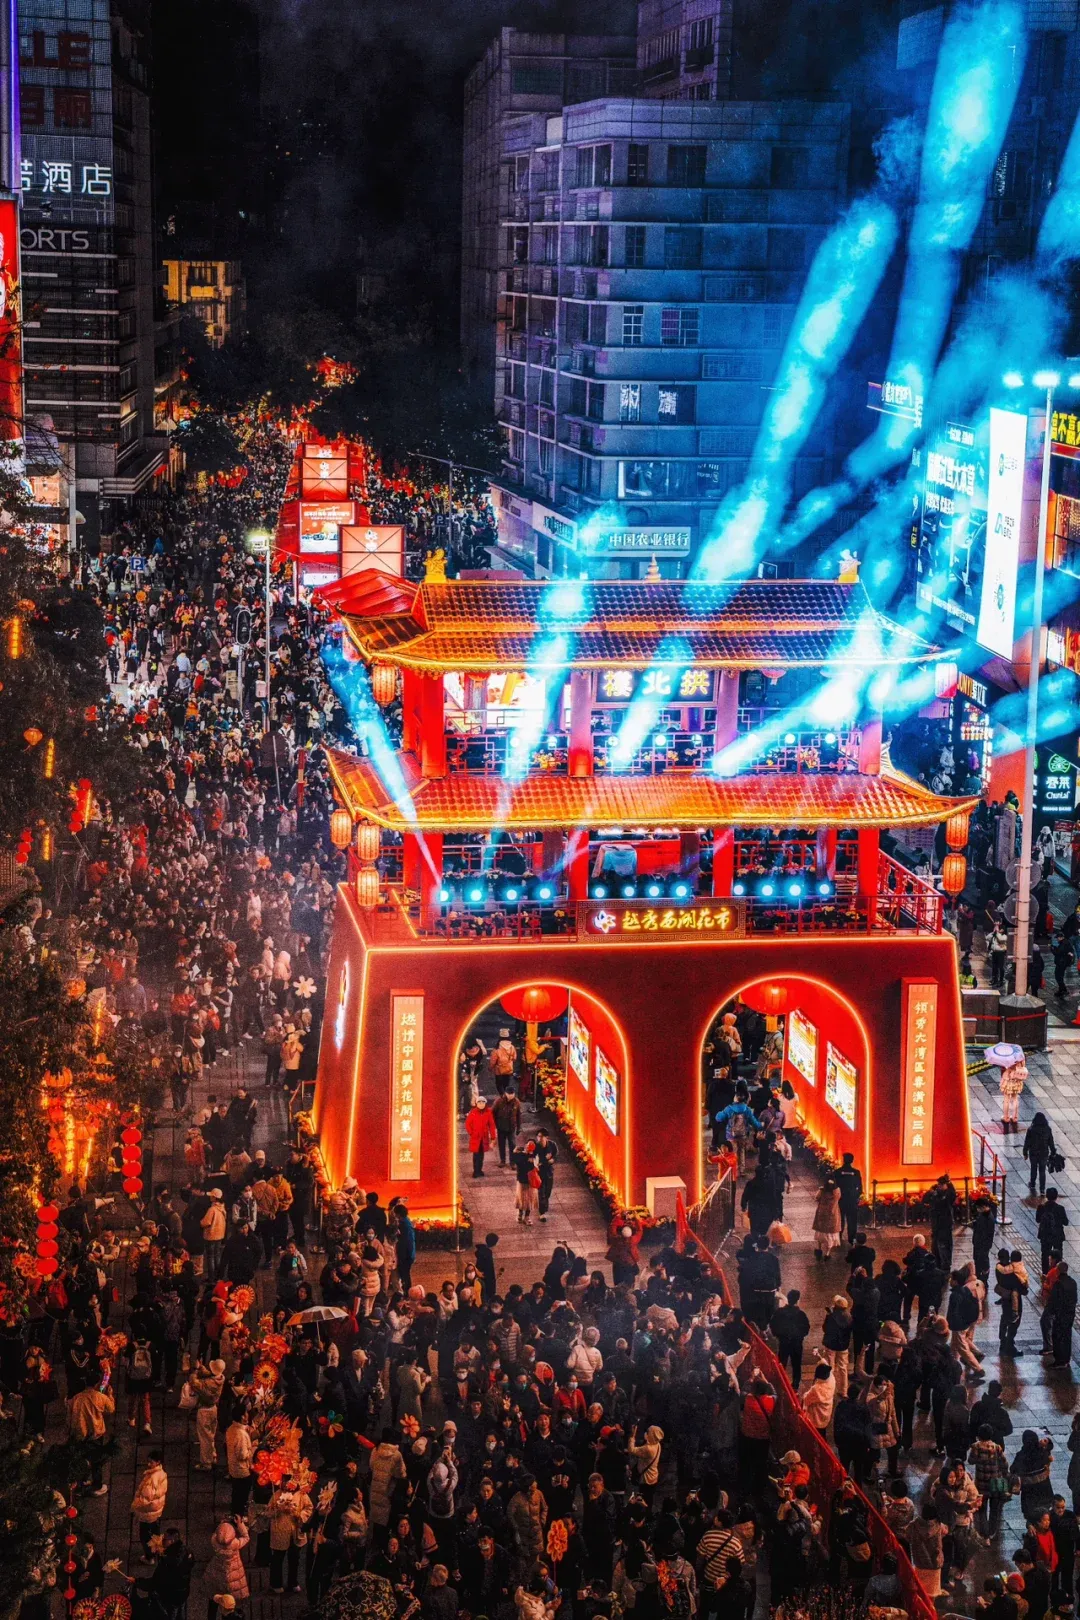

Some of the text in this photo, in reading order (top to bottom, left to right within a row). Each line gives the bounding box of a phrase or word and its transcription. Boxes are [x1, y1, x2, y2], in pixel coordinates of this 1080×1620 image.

[20, 227, 90, 250] ORTS
[609, 532, 690, 546] 中国农业银行
[622, 907, 731, 931] 越秀西湖花市
